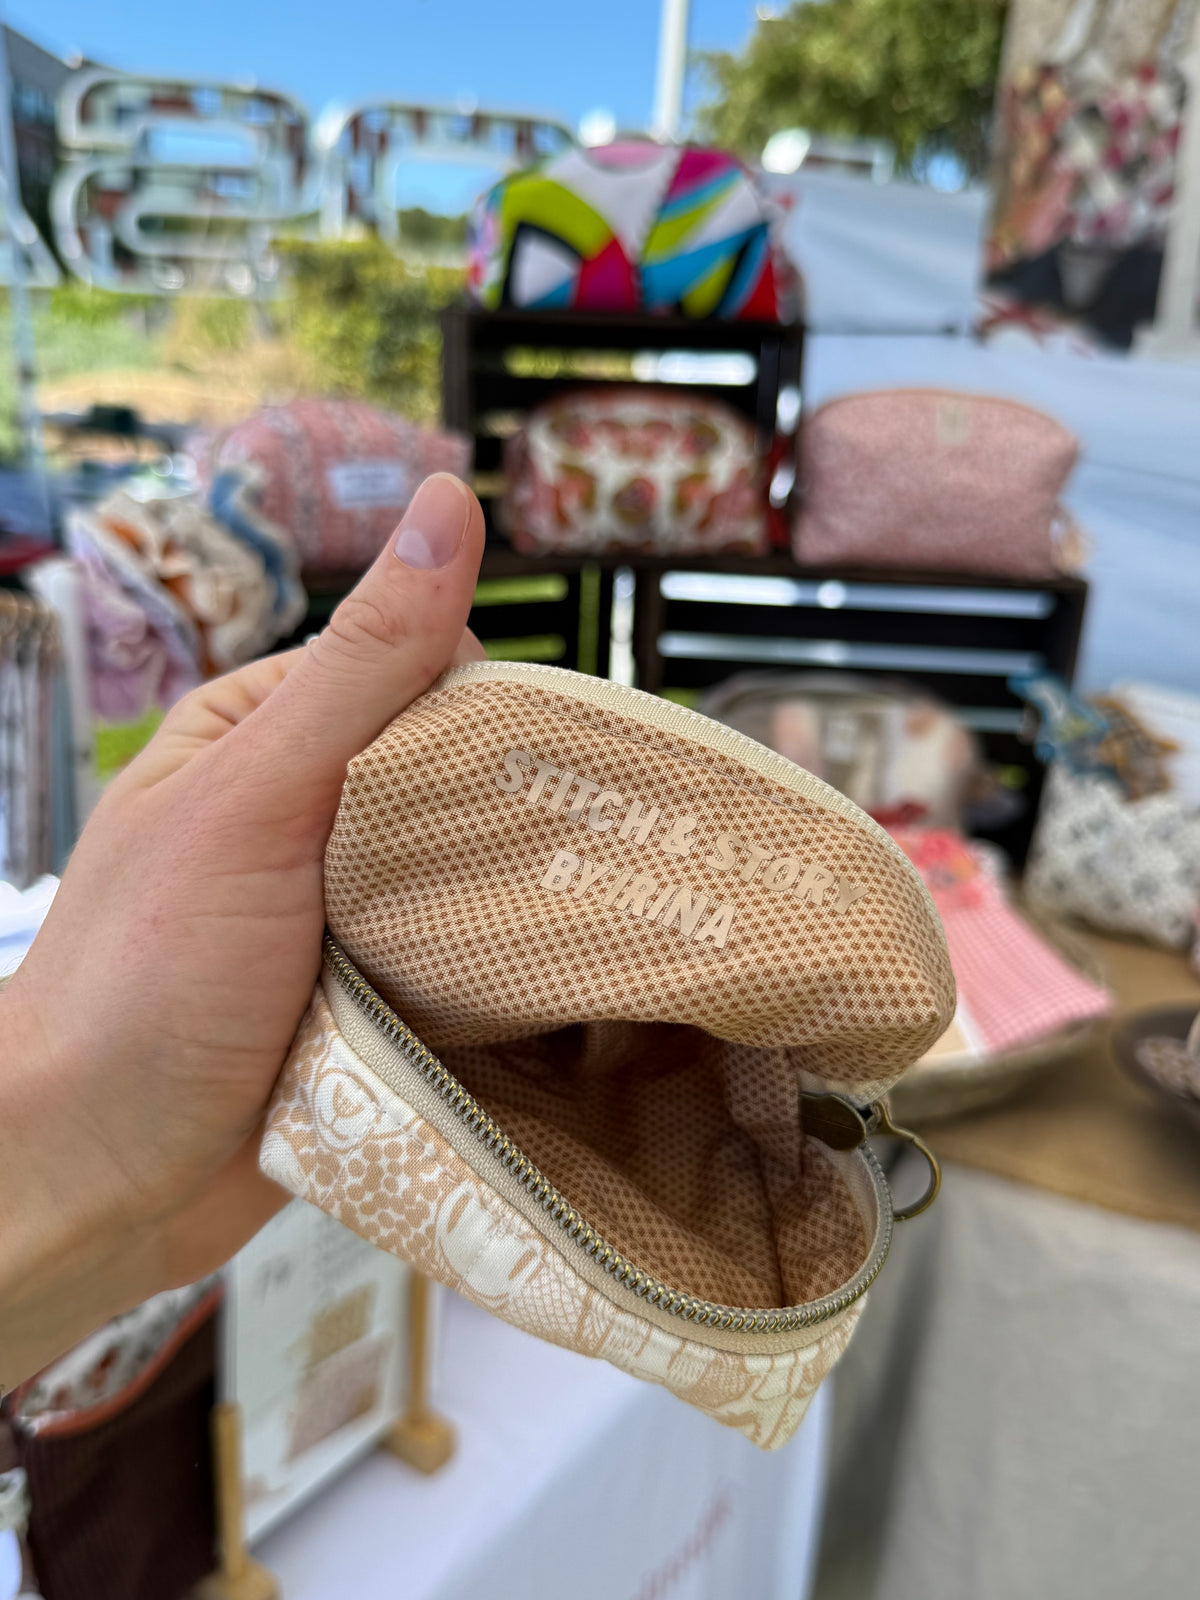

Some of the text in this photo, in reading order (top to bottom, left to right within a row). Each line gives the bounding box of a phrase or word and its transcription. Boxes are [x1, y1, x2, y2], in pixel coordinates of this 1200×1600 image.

[495, 749, 868, 915] STITCH & STORY
[540, 849, 737, 948] BY IRINA
